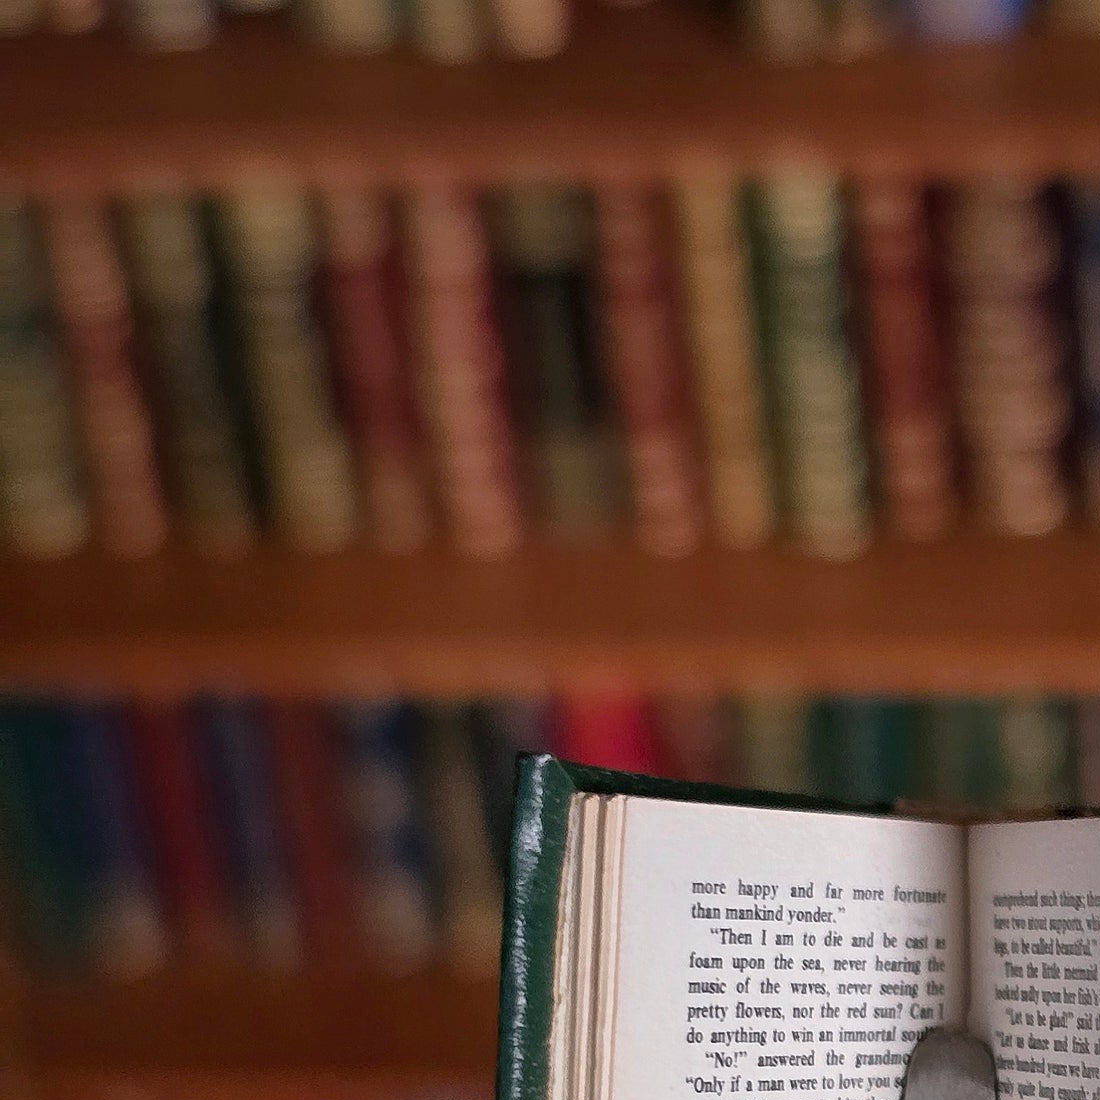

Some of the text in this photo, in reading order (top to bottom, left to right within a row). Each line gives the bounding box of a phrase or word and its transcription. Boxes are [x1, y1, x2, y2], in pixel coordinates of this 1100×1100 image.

[692, 883, 726, 895] more
[738, 878, 779, 900] happy
[791, 882, 814, 898] and
[825, 882, 843, 899] far
[853, 889, 884, 901] more
[691, 902, 721, 919] than
[725, 904, 783, 921] mankind
[761, 929, 767, 946] I
[775, 934, 794, 946] am
[803, 932, 816, 946] to
[824, 930, 843, 947] die
[850, 932, 874, 948] and
[883, 932, 897, 948] be
[905, 936, 928, 950] cast
[689, 951, 945, 975] foam upon the sea, never hearing the
[688, 976, 944, 999] music of the waves, never seeing the
[687, 1003, 728, 1022] pretty
[736, 1001, 785, 1021] flowers,
[793, 1007, 814, 1019] nor
[820, 1002, 840, 1019] the
[847, 1002, 867, 1018] red
[873, 1002, 903, 1019] sun?
[909, 1003, 933, 1020] Can
[686, 1027, 703, 1043] do
[710, 1026, 767, 1047] anything
[773, 1029, 785, 1043] to
[791, 1027, 814, 1043] win
[819, 1031, 833, 1042] an
[839, 1026, 896, 1042] immortal
[757, 1050, 815, 1067] answered
[826, 1049, 845, 1066] the
[855, 1049, 911, 1067] grandmo
[730, 1075, 741, 1092] if
[746, 1080, 753, 1092] a
[757, 1080, 785, 1092] man
[789, 1079, 818, 1090] were
[822, 1076, 834, 1090] to
[839, 1073, 864, 1090] love
[865, 1077, 890, 1092] you
